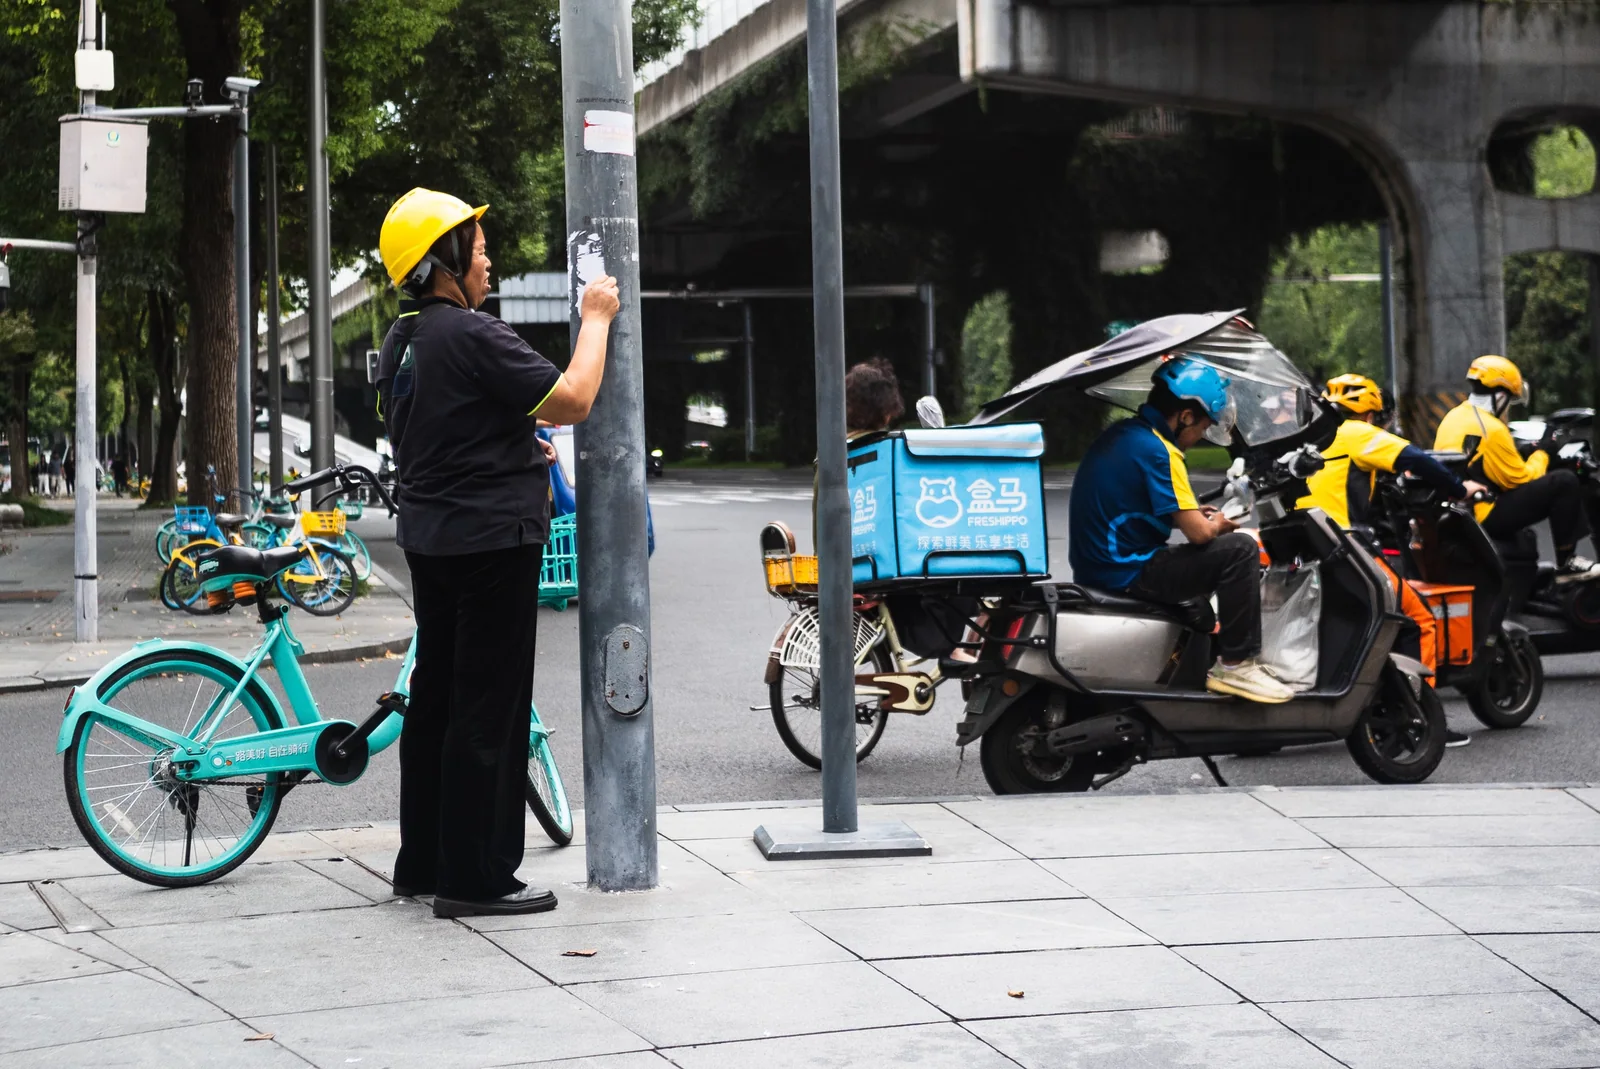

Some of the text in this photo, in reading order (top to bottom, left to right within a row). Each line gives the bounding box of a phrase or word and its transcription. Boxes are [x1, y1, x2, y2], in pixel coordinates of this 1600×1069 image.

[854, 486, 876, 523] 盒马
[967, 478, 1027, 513] 盒马
[967, 515, 1028, 526] FRESHIPPO
[918, 533, 1029, 550] 探索鲜美 乐享生活
[226, 742, 309, 762] 一路美好 自在骑行
